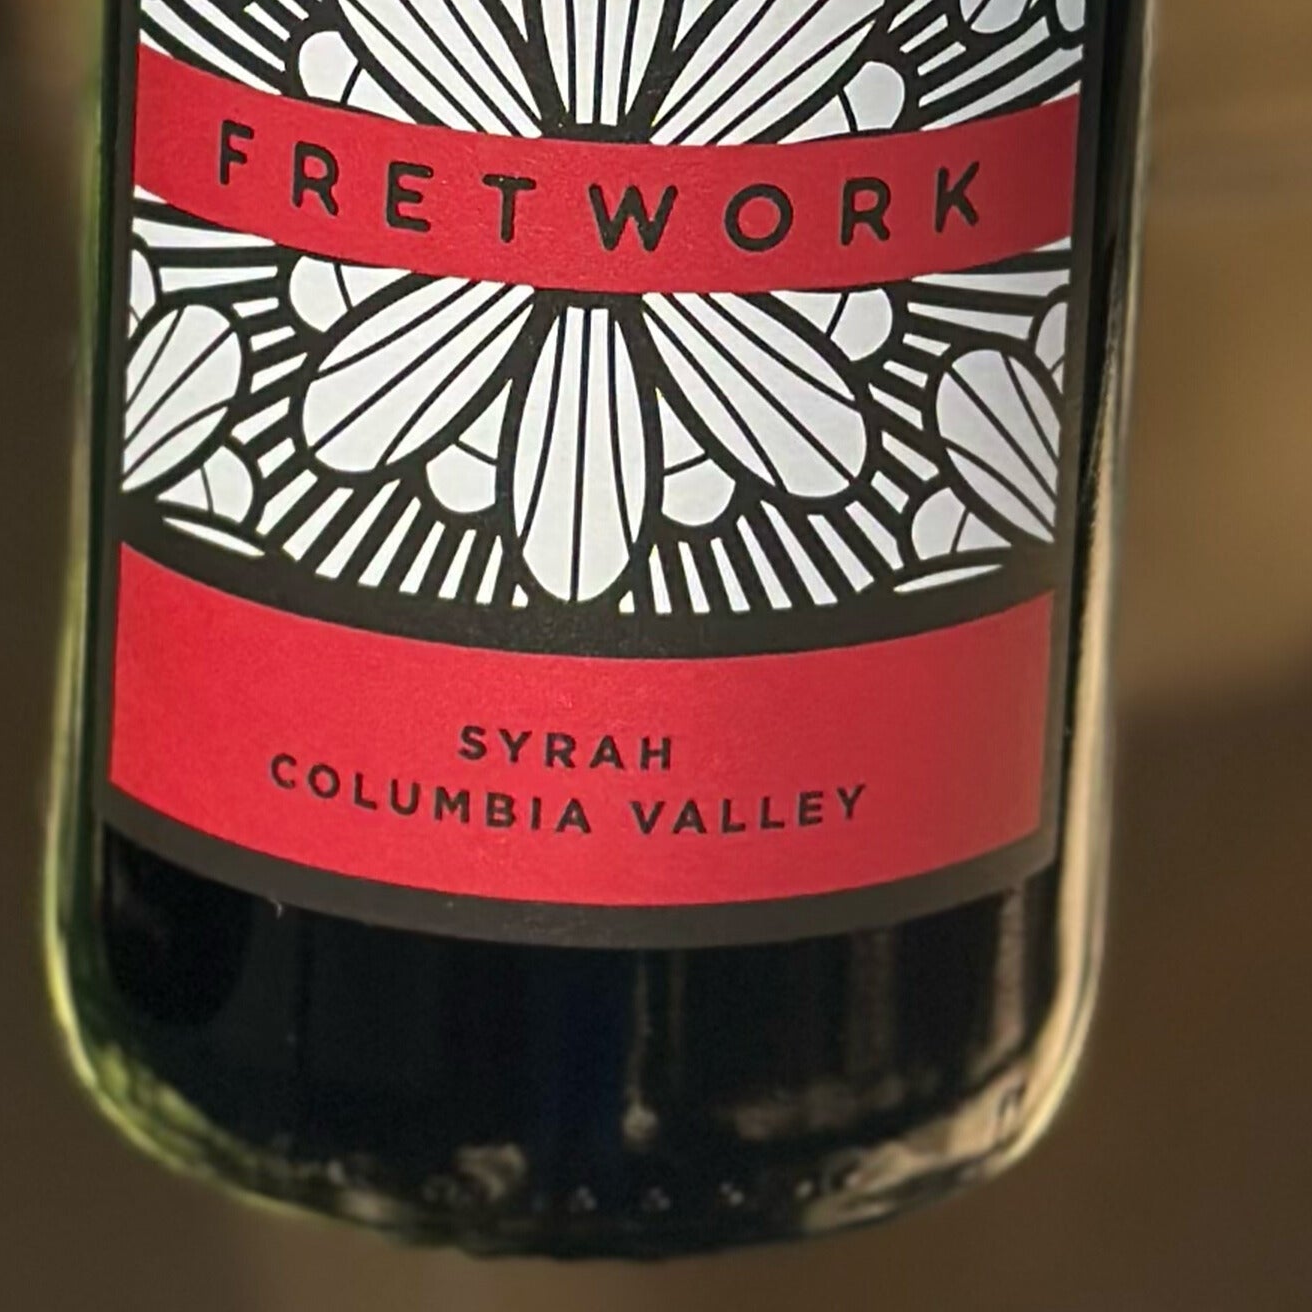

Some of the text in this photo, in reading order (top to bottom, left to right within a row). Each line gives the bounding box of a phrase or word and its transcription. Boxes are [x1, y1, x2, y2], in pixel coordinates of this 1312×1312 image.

[220, 118, 981, 253] FRETWORK
[458, 724, 673, 772] SYRAH
[269, 752, 868, 836] COLUMBIA VALLEY
